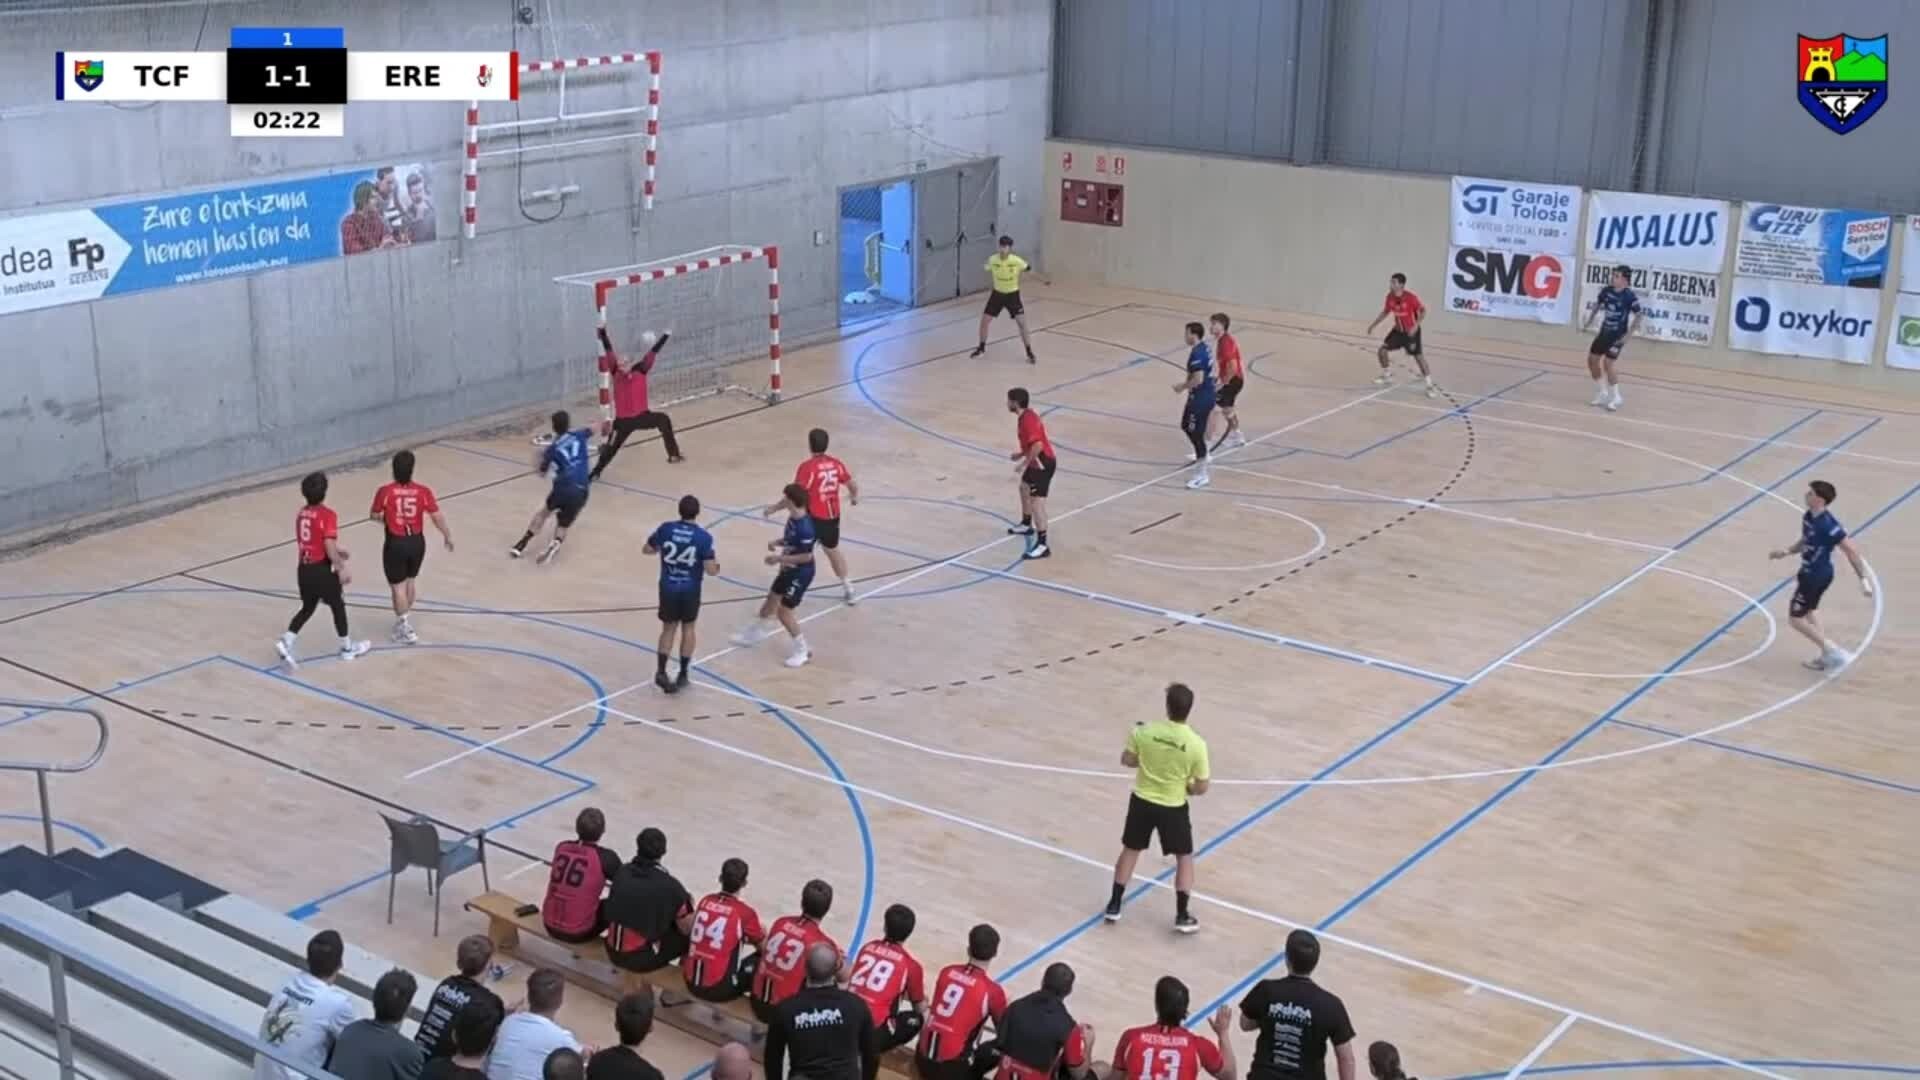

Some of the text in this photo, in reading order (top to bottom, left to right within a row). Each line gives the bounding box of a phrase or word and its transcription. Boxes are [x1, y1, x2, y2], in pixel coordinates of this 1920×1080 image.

[143, 191, 308, 232] Zure etorkizuna
[1511, 188, 1570, 209] Garaje
[1511, 203, 1569, 223] Tolosa
[144, 215, 311, 265] hemen hasten da
[1595, 210, 1718, 249] INSALUS
[1848, 233, 1885, 245] Service
[1849, 220, 1888, 234] BOSCH
[1, 246, 54, 276] dea
[67, 237, 105, 270] Fp
[1452, 247, 1563, 299] SMG
[1652, 271, 1717, 298] TABERNA
[1779, 309, 1872, 338] oxykor
[817, 469, 839, 493] 25
[395, 497, 417, 517] 15
[300, 519, 311, 541] 6
[662, 540, 698, 567] 24
[551, 854, 588, 888] 36
[690, 911, 728, 949] 64
[765, 931, 806, 971] 43
[850, 953, 896, 993] 28
[935, 982, 965, 1018] 9
[1138, 1046, 1181, 1080] 13
